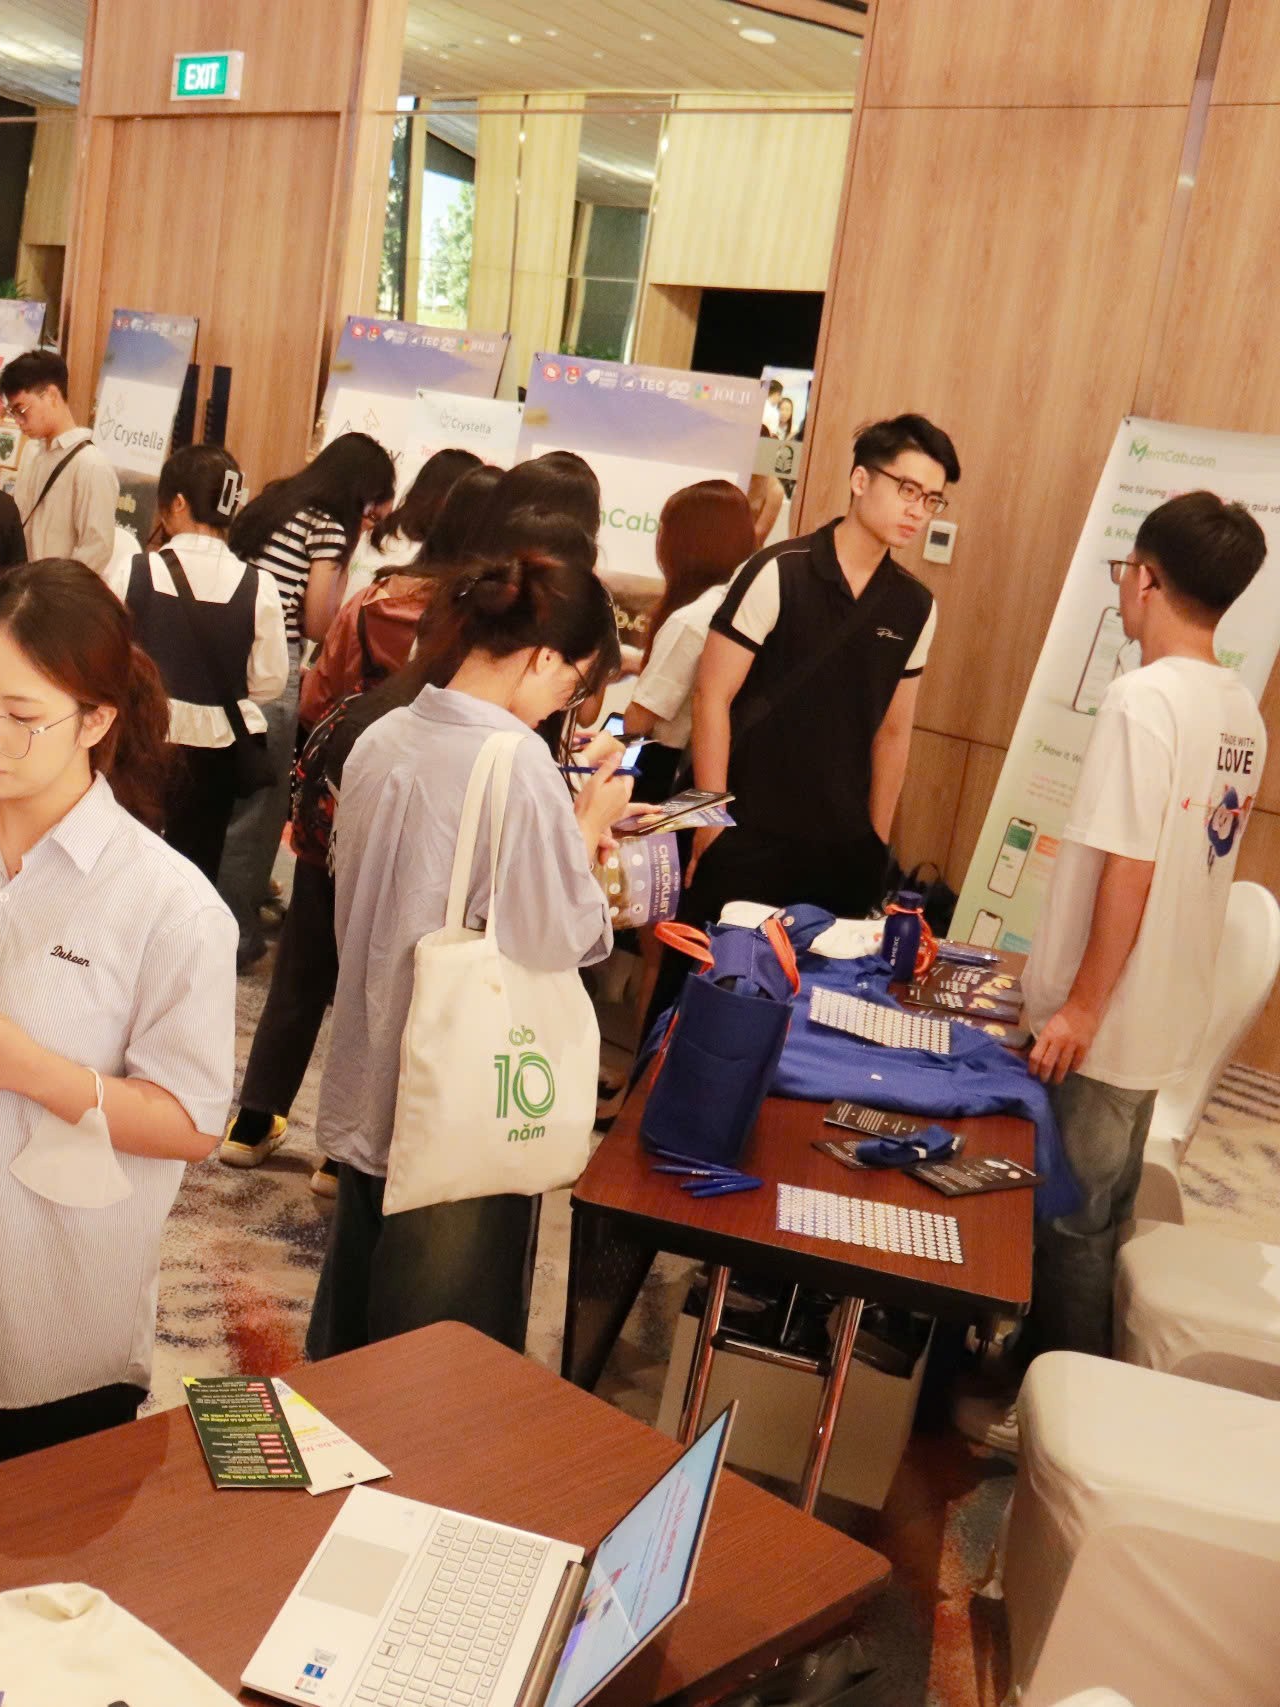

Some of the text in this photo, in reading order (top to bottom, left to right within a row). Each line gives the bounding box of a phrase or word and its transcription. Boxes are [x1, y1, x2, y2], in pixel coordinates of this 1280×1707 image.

[184, 62, 219, 90] EXIT
[641, 378, 665, 391] TEC
[113, 423, 164, 450] Crystella
[451, 418, 492, 434] Crystella
[1129, 440, 1216, 468] MemCab.com
[1217, 746, 1254, 774] LOVE
[658, 844, 671, 914] CHECKLIST
[50, 945, 90, 967] Dukeen
[494, 1051, 555, 1119] 10
[507, 1123, 546, 1142] năm
